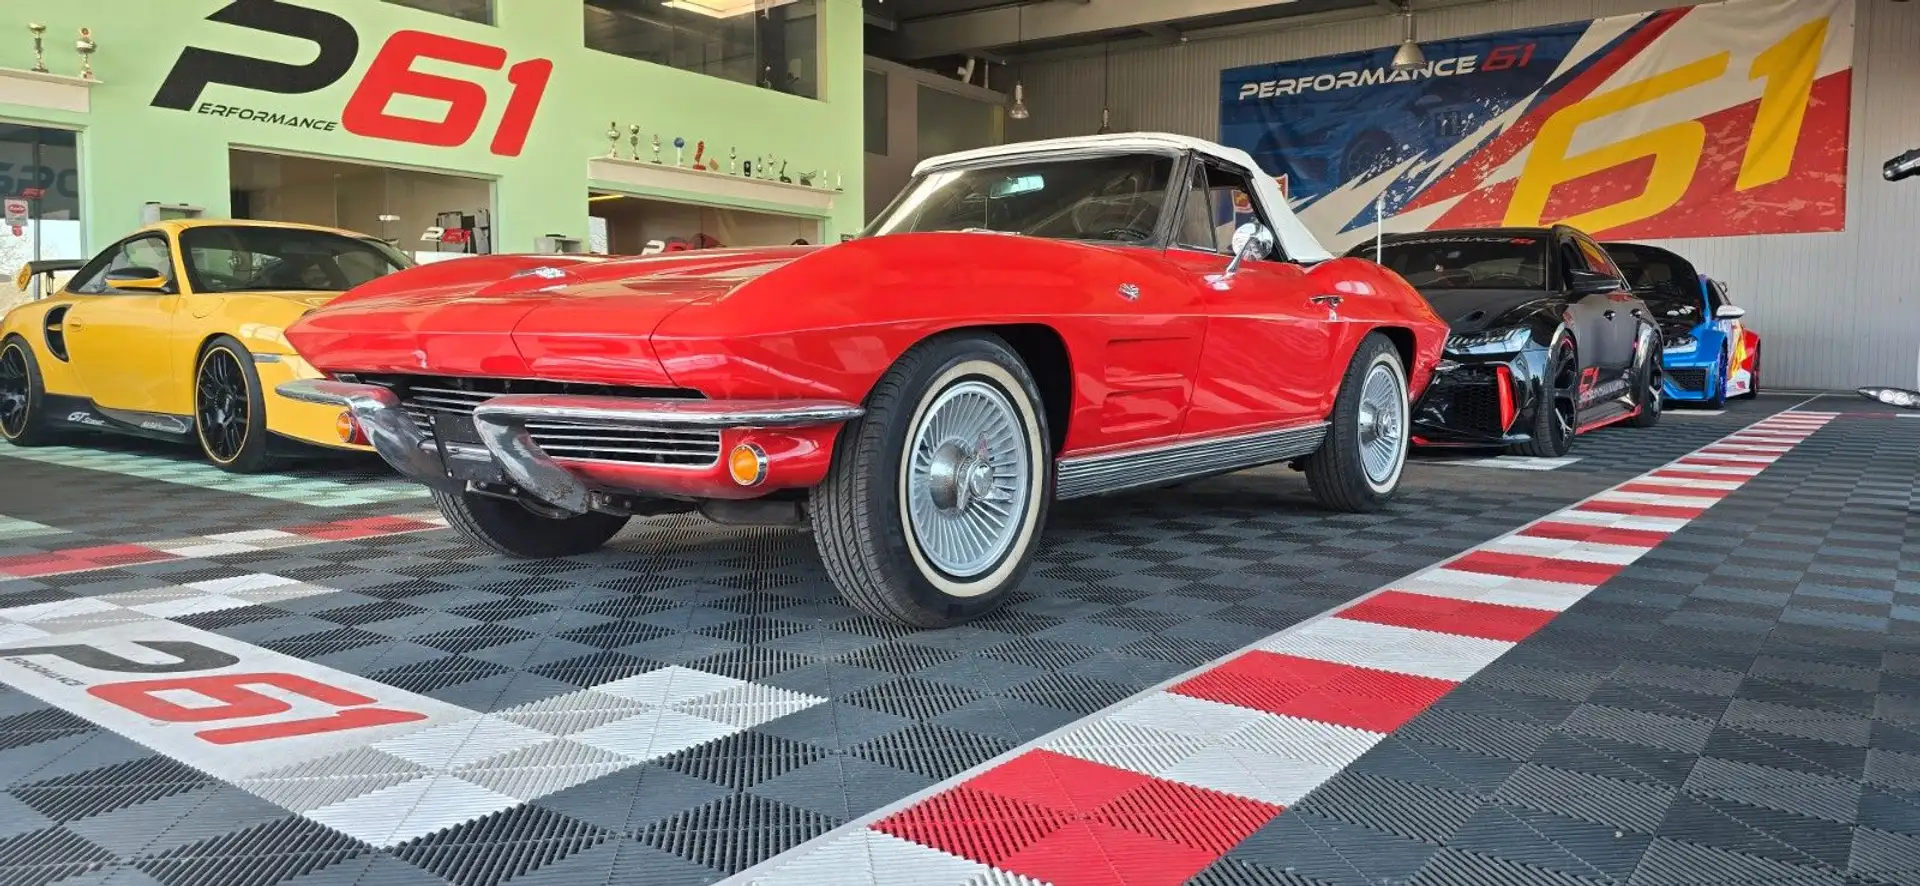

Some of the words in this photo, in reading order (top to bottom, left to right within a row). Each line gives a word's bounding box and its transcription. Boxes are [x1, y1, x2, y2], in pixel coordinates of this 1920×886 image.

[1239, 55, 1478, 101] PERFORMANCE
[1481, 43, 1536, 72] 61
[1503, 17, 1829, 234] 61
